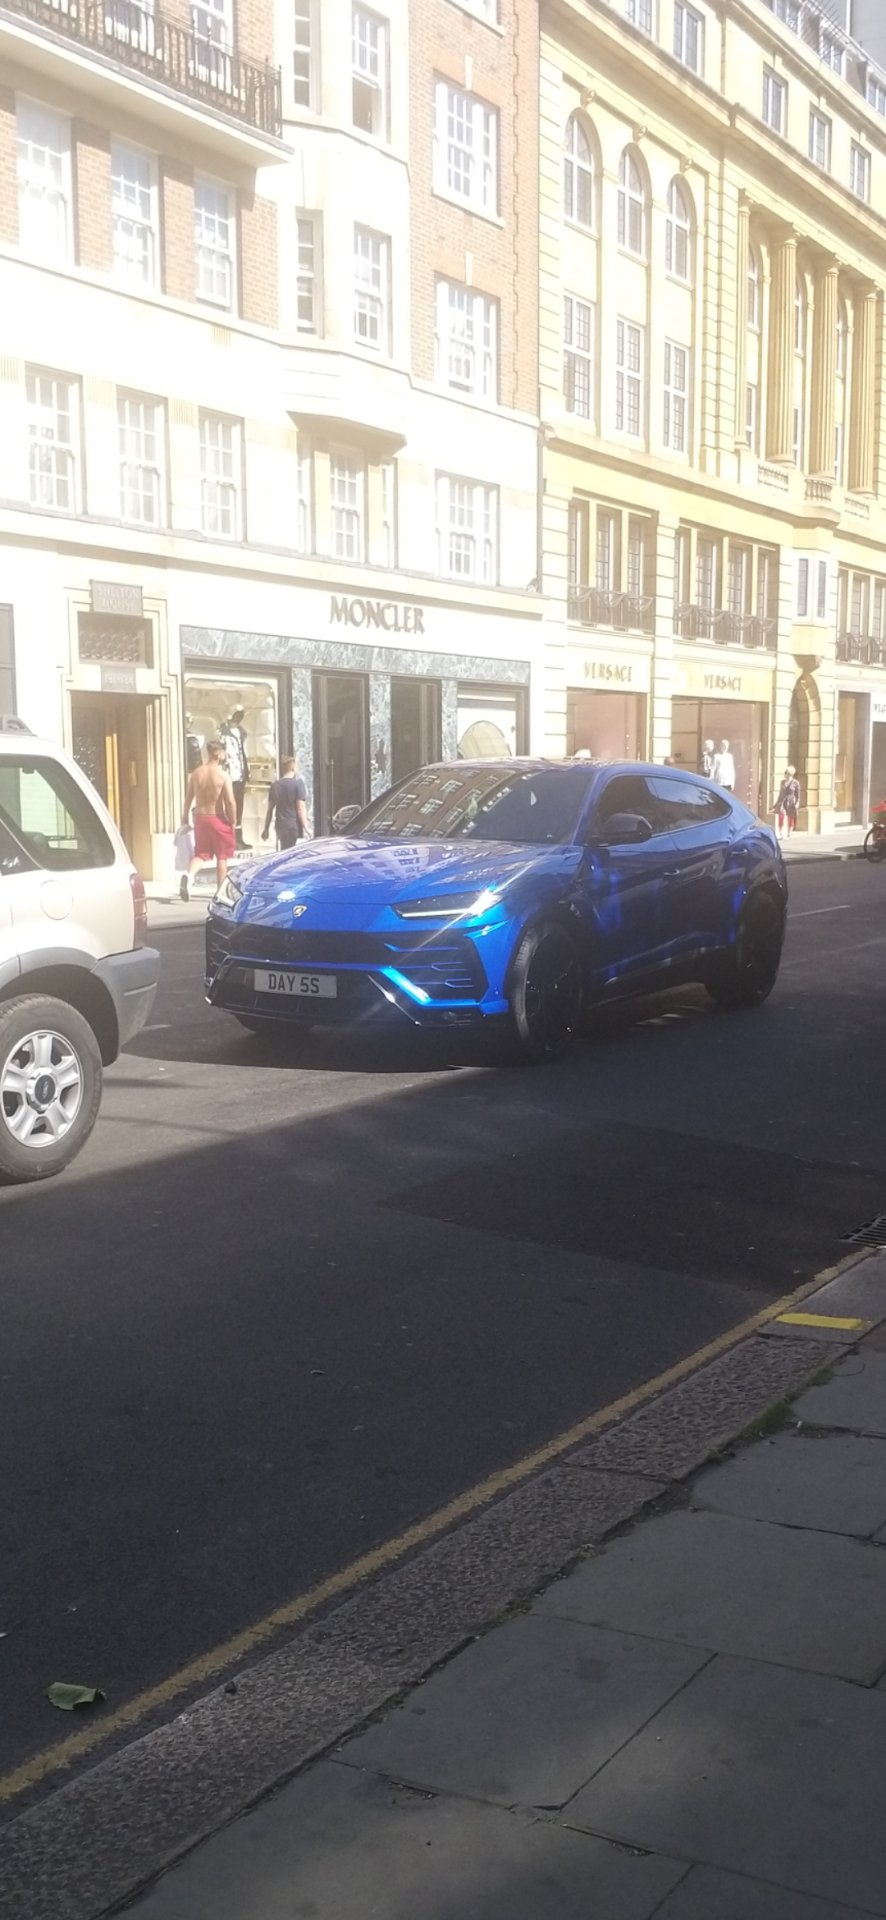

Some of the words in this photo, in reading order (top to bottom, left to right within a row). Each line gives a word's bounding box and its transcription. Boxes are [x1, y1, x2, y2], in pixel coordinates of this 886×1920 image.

[329, 595, 425, 634] MONCLER
[584, 662, 632, 682] VERSACE
[704, 674, 742, 692] VERSACE
[268, 974, 296, 992] DAY
[300, 977, 320, 993] 5S
